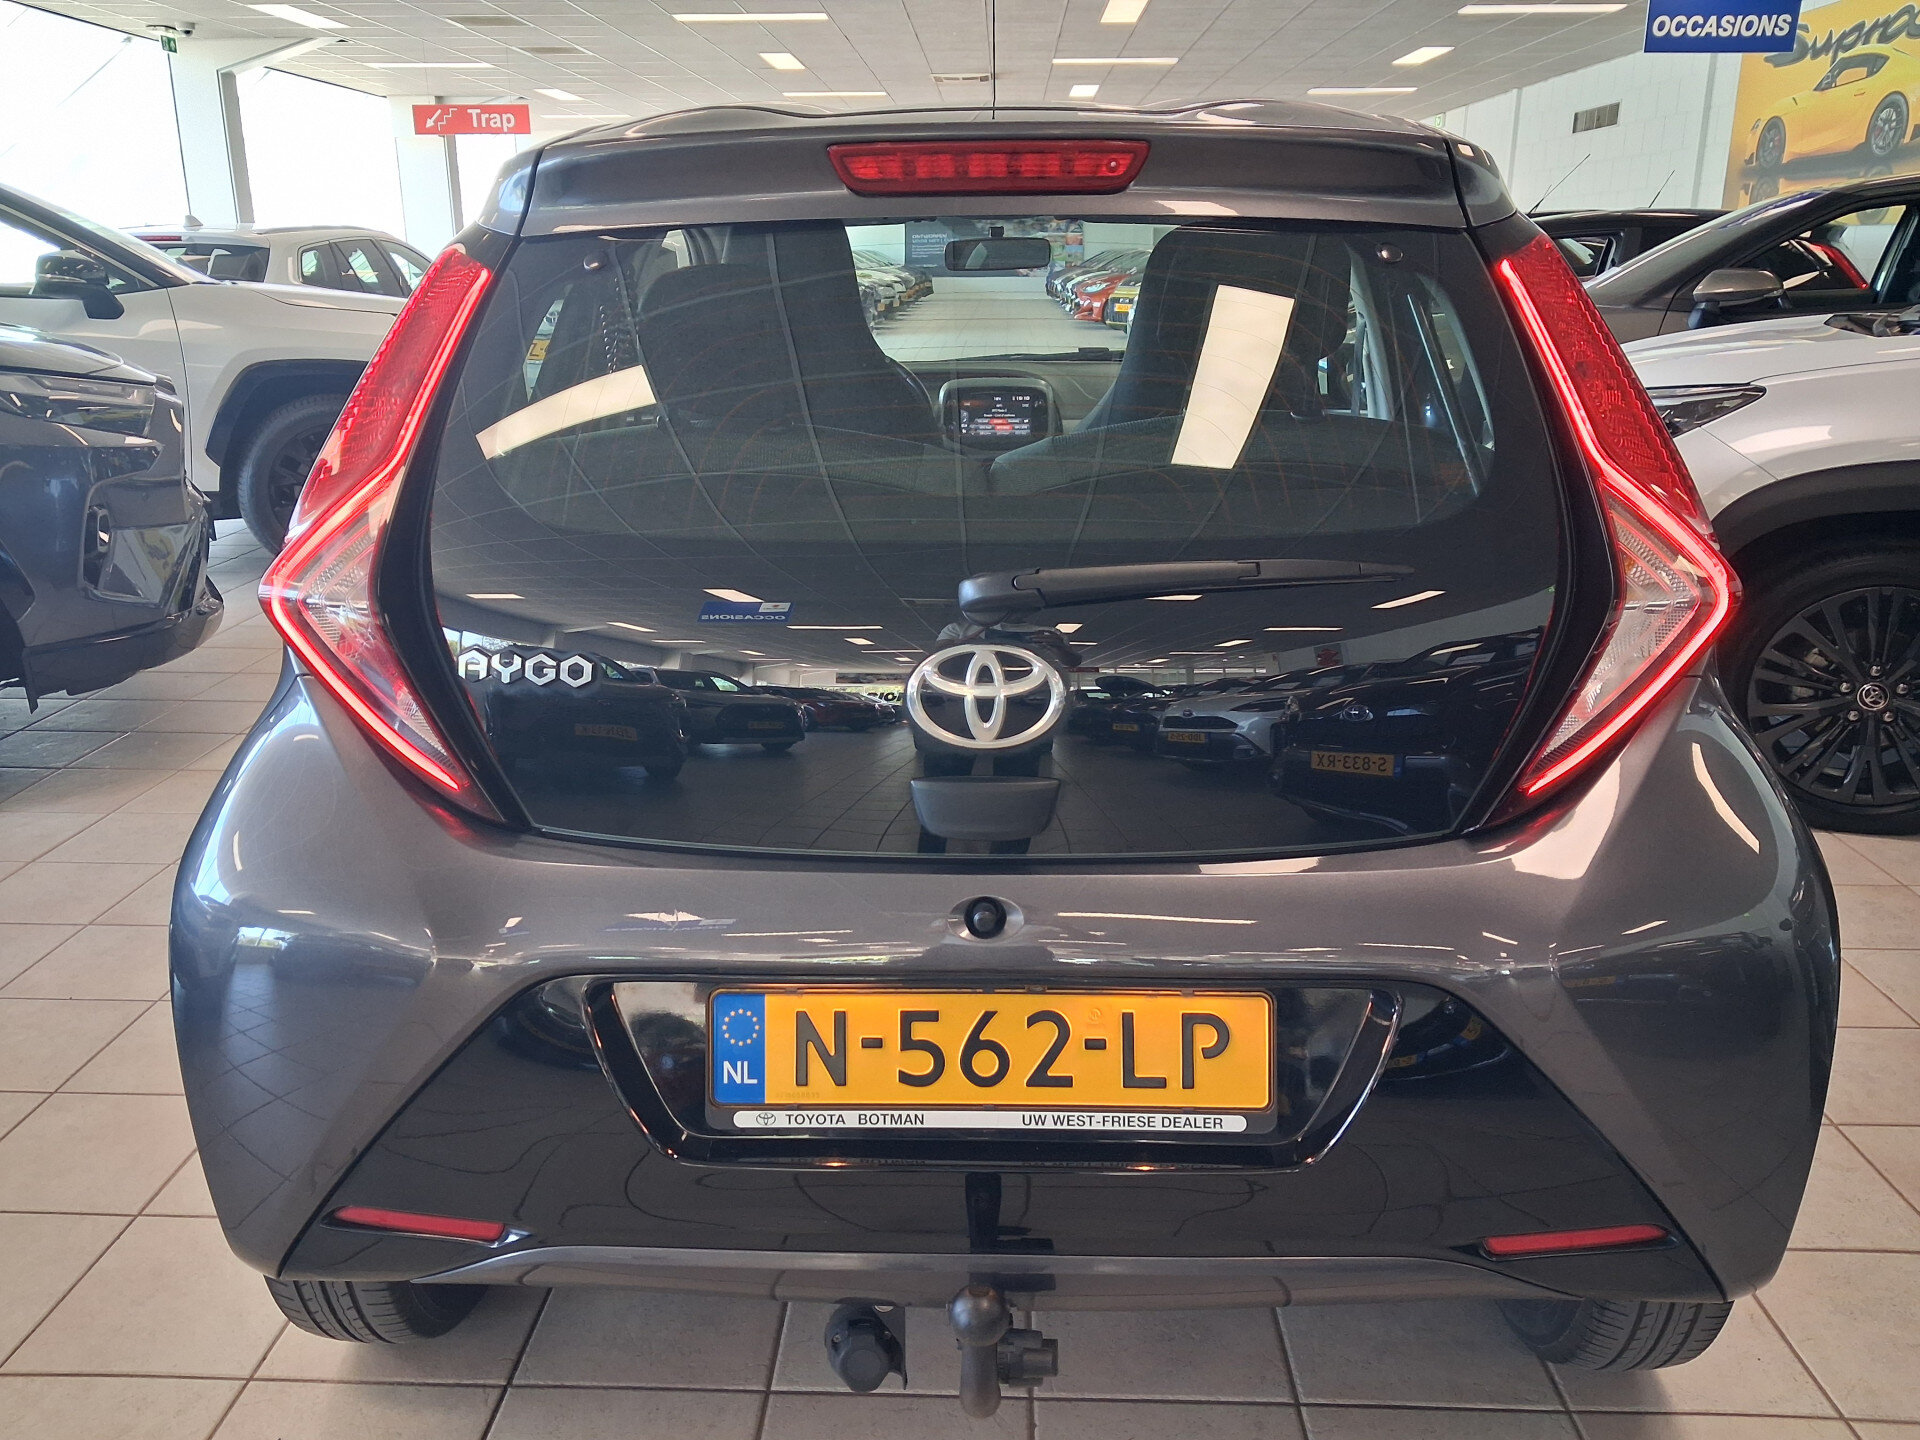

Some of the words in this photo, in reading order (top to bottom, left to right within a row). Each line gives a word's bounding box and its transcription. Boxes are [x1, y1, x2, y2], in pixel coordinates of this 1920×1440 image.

[1652, 14, 1792, 38] OCCASIONS
[467, 108, 515, 132] Trap
[458, 649, 593, 688] AYGO
[795, 1009, 1231, 1089] N-562-LP
[723, 1060, 758, 1085] NL
[786, 1113, 846, 1125] TOYOTA
[858, 1113, 925, 1126] BOTMAN
[1022, 1114, 1047, 1127] UW
[1052, 1114, 1156, 1128] WEST-FRIESE
[1161, 1116, 1223, 1130] DEALER
